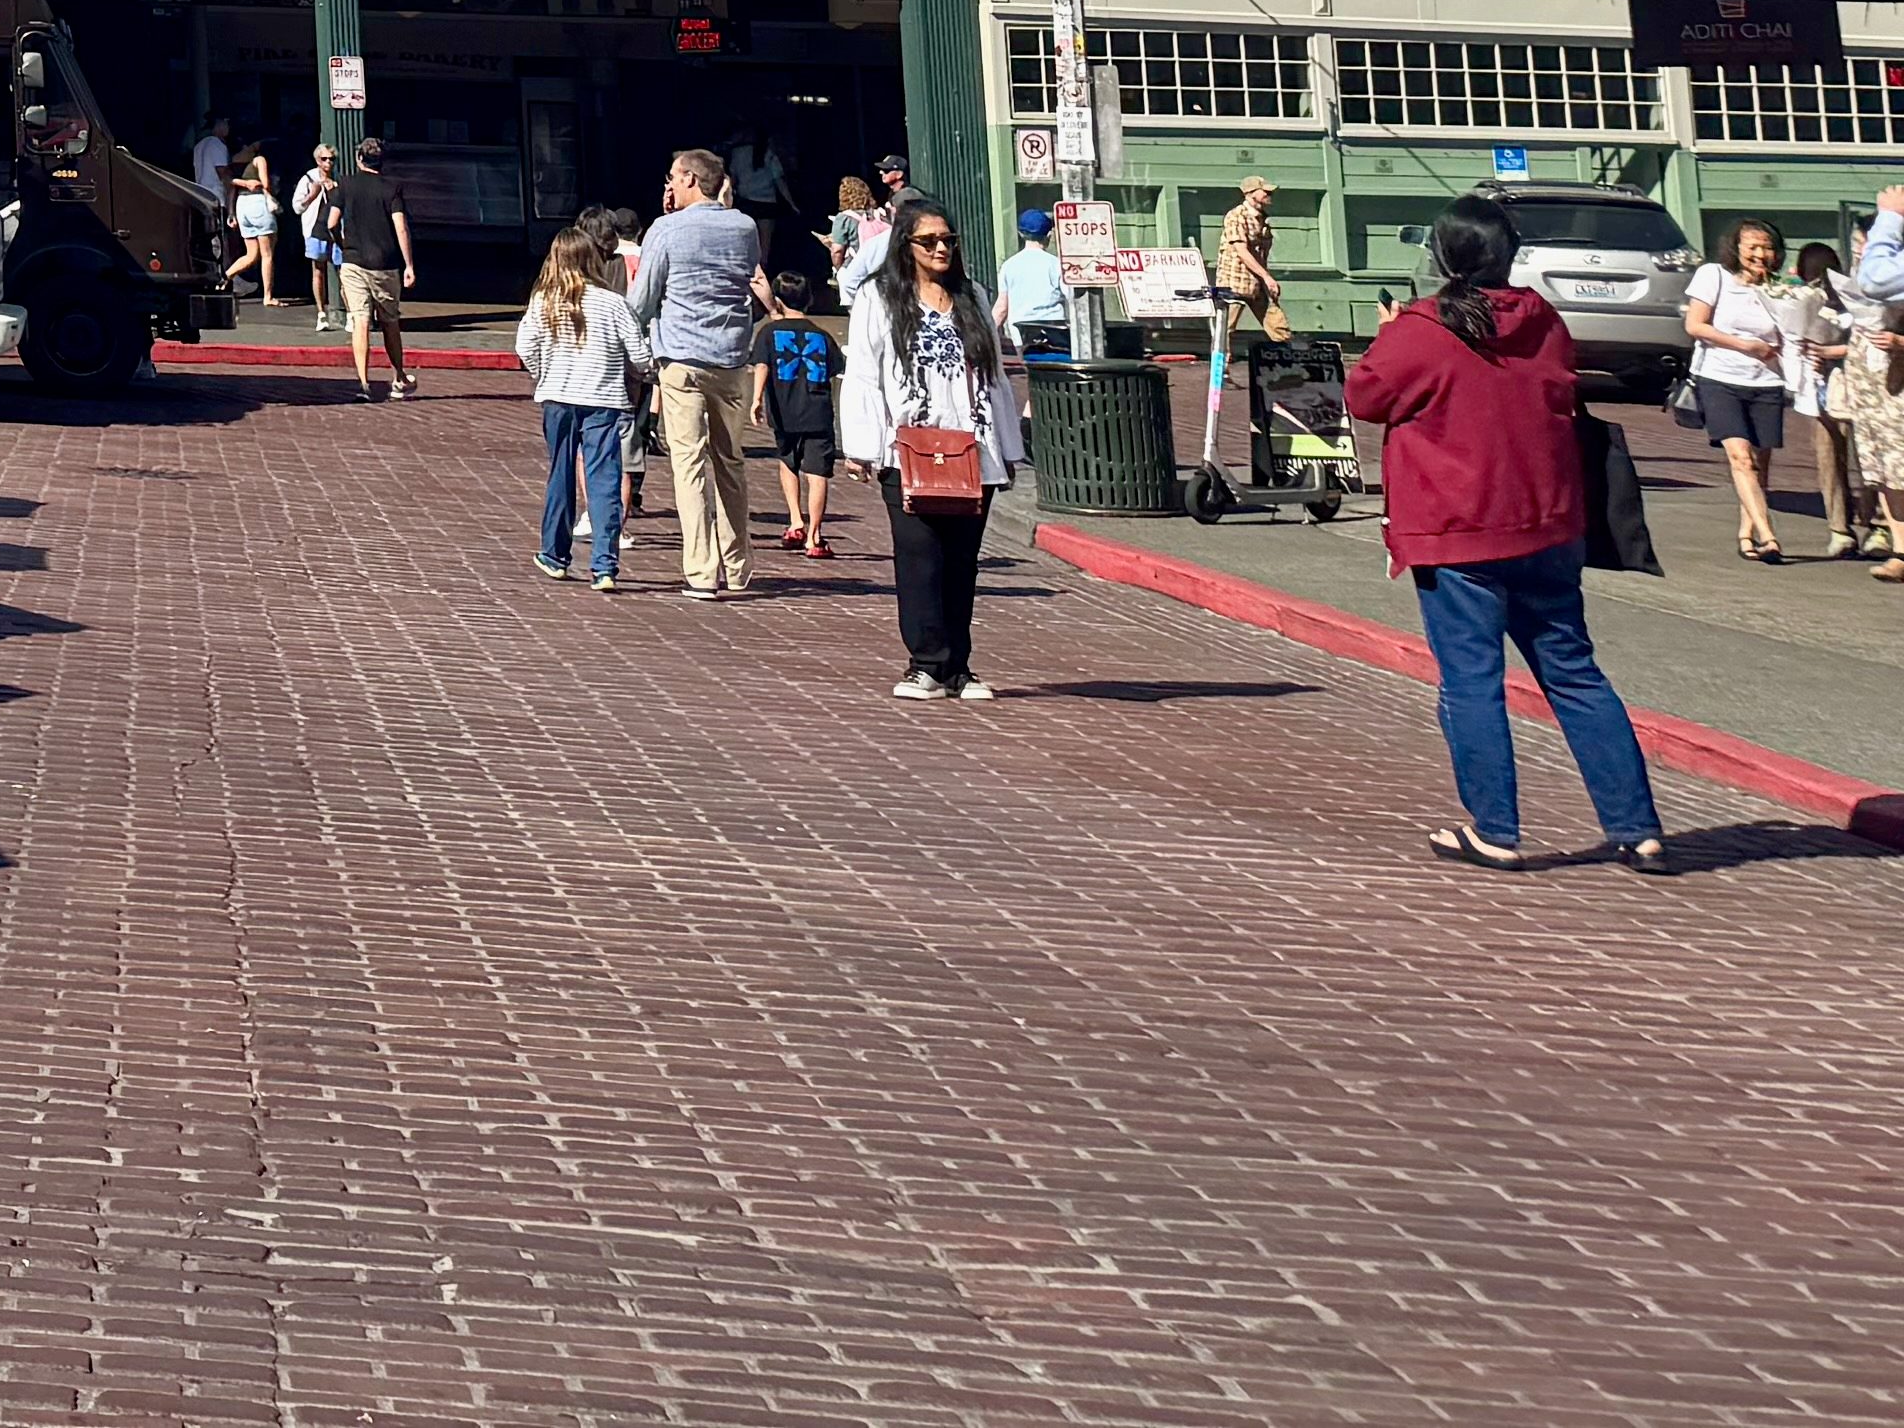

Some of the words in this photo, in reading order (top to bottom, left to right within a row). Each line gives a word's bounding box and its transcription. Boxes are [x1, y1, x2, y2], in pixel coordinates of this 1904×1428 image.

[1680, 24, 1734, 40] ADITI
[1739, 22, 1792, 39] CHAI
[1058, 205, 1075, 218] NO
[1064, 222, 1108, 237] STOPS
[1118, 252, 1141, 271] NO
